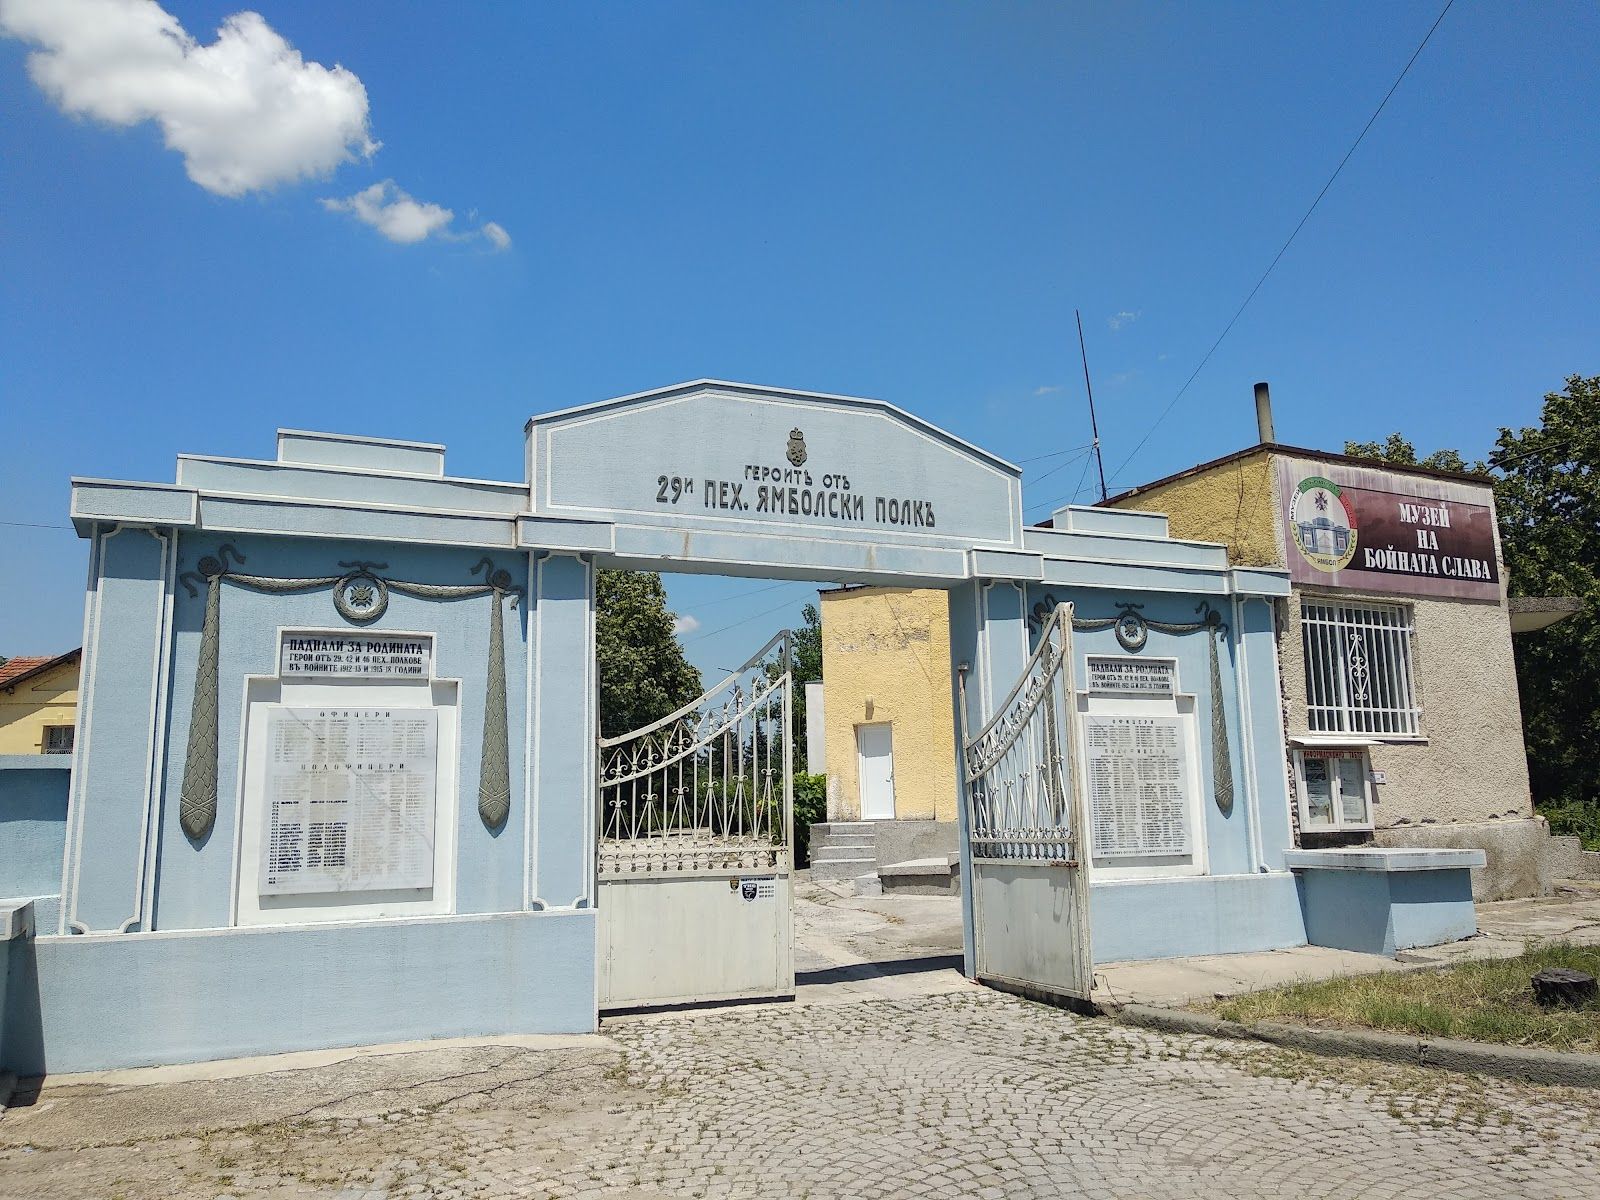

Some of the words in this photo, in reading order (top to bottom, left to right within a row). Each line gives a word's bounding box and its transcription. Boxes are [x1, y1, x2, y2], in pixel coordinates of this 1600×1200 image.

[822, 473, 851, 491] ОТЪ
[704, 479, 749, 511] ПЕХ.
[756, 485, 865, 522] ЯМБОЛСКИ
[875, 496, 936, 528] ПОЛКЪ
[1398, 501, 1451, 528] МУЗЕЙ
[1416, 529, 1439, 551] НА
[1363, 545, 1439, 575] БОЙНАТА
[1441, 556, 1492, 580] СЛАВА
[289, 639, 344, 652] ПАДНАЛИ
[347, 641, 362, 653] ЗА
[366, 641, 423, 654] РОДИНАТА
[289, 653, 313, 662] ГЕРОИ
[315, 654, 332, 662] ОТЪ
[390, 656, 422, 665] ПОЛКОВЕ
[289, 663, 301, 671] ВЪ
[304, 663, 338, 672] ВОЙНИТЕ
[363, 665, 369, 673] И
[1091, 663, 1123, 673] ПАДНАЛИ
[1124, 664, 1133, 674] ЗА
[1135, 664, 1170, 675] РОДИНАТА
